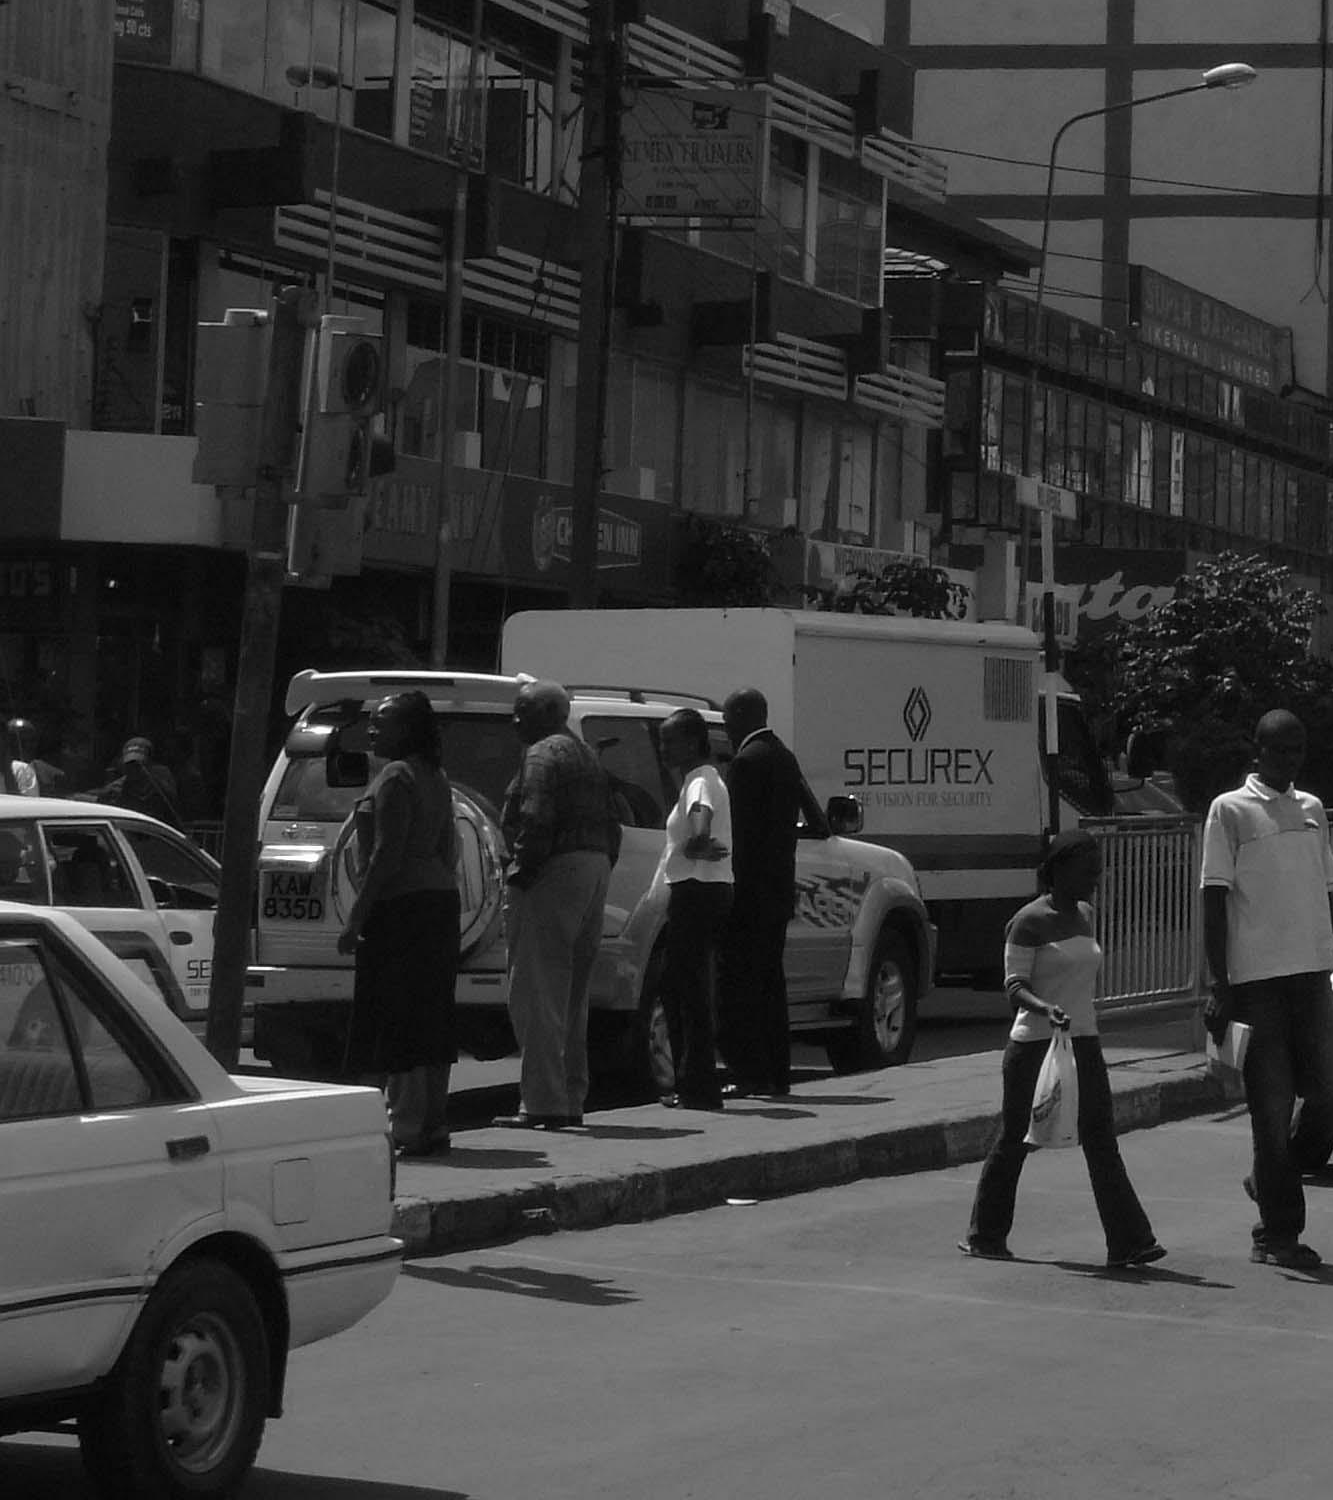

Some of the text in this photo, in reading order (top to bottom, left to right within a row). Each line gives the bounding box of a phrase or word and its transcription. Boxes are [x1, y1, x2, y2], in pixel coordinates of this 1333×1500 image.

[844, 748, 994, 786] SECUREX
[875, 791, 913, 807] VISION
[916, 791, 938, 807] FOR
[940, 791, 993, 808] SECURITY
[271, 874, 313, 896] KAW
[264, 898, 323, 920] 835D
